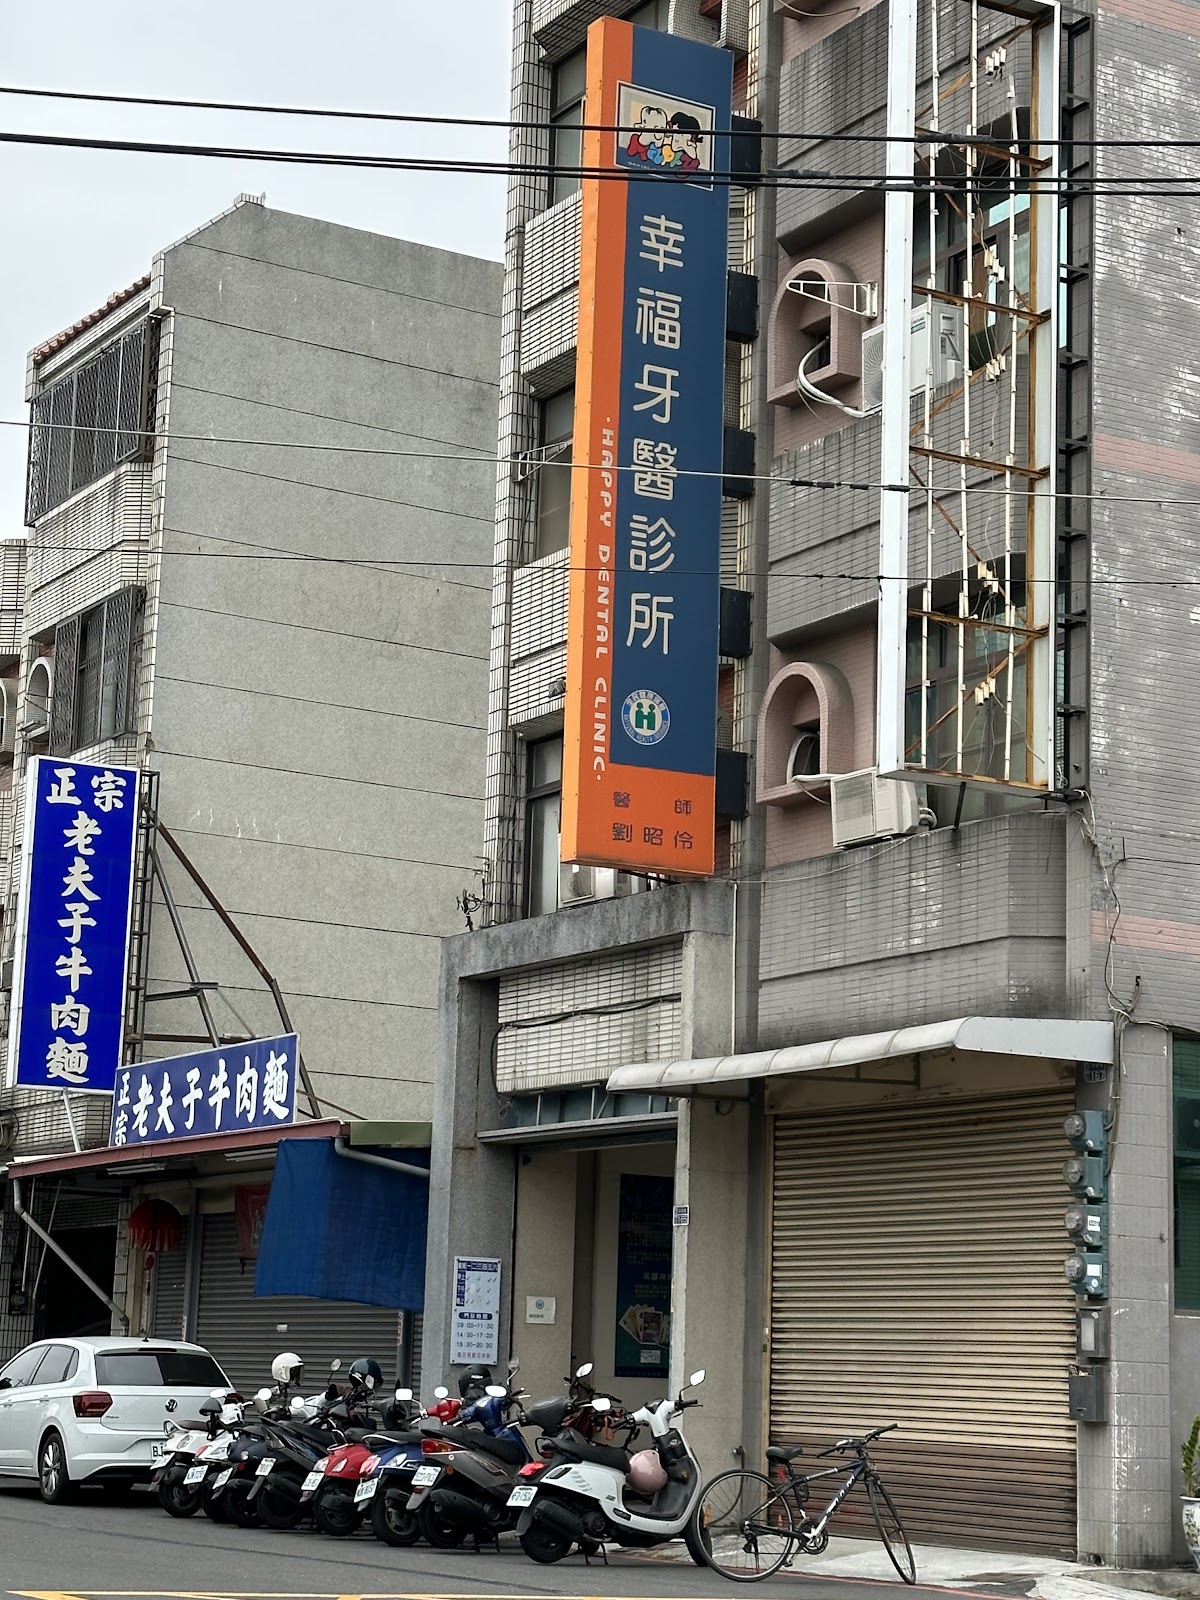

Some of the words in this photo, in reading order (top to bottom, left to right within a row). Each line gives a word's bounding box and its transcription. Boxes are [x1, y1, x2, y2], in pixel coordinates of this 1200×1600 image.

[600, 428, 614, 527] HAPPY
[626, 214, 686, 655] 幸福牙醫診所
[596, 544, 610, 659] DENTAL
[593, 676, 607, 772] CLINIC
[46, 767, 127, 813] 正宗
[612, 822, 694, 850] 劉昭伶
[45, 811, 102, 1084] 老夫子牛肉麵
[114, 1071, 131, 1147] 正宗
[132, 1049, 290, 1138] 老夫子牛肉麵
